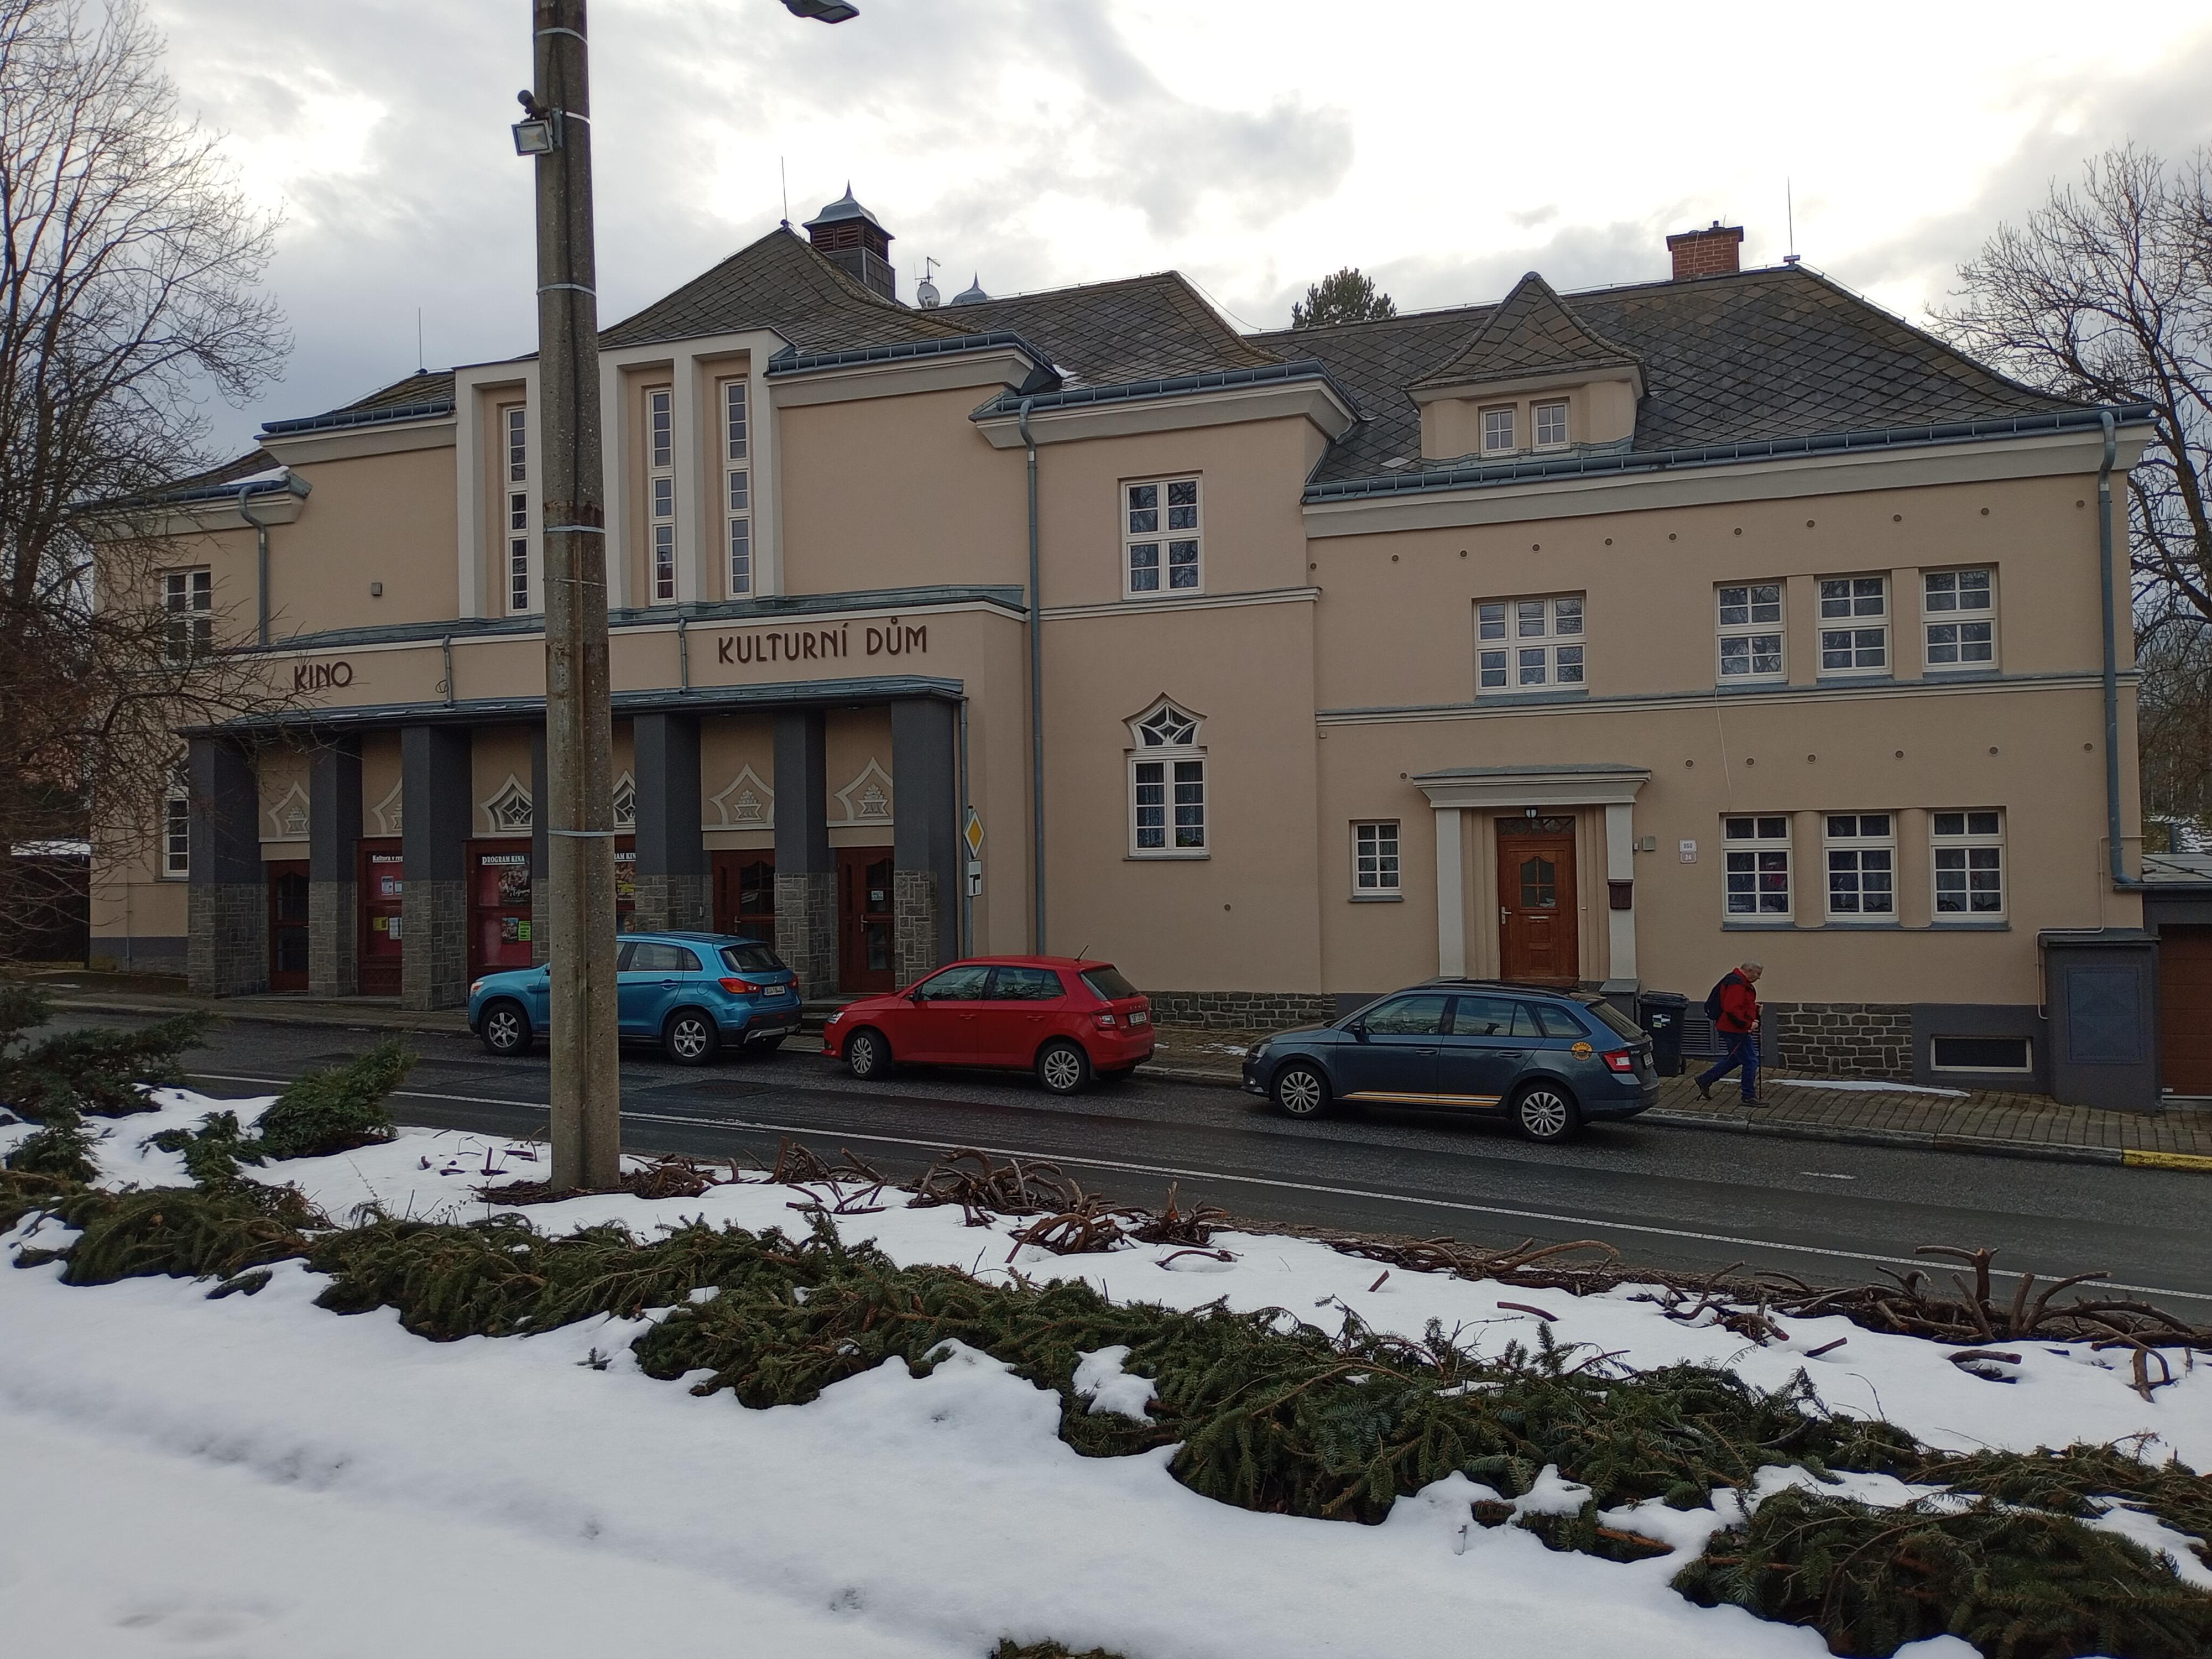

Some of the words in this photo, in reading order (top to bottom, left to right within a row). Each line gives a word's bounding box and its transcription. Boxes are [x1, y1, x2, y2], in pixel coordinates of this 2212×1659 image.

[719, 622, 849, 664] KULTURNÍ
[866, 617, 927, 655] DŮM
[294, 661, 353, 690] KINO
